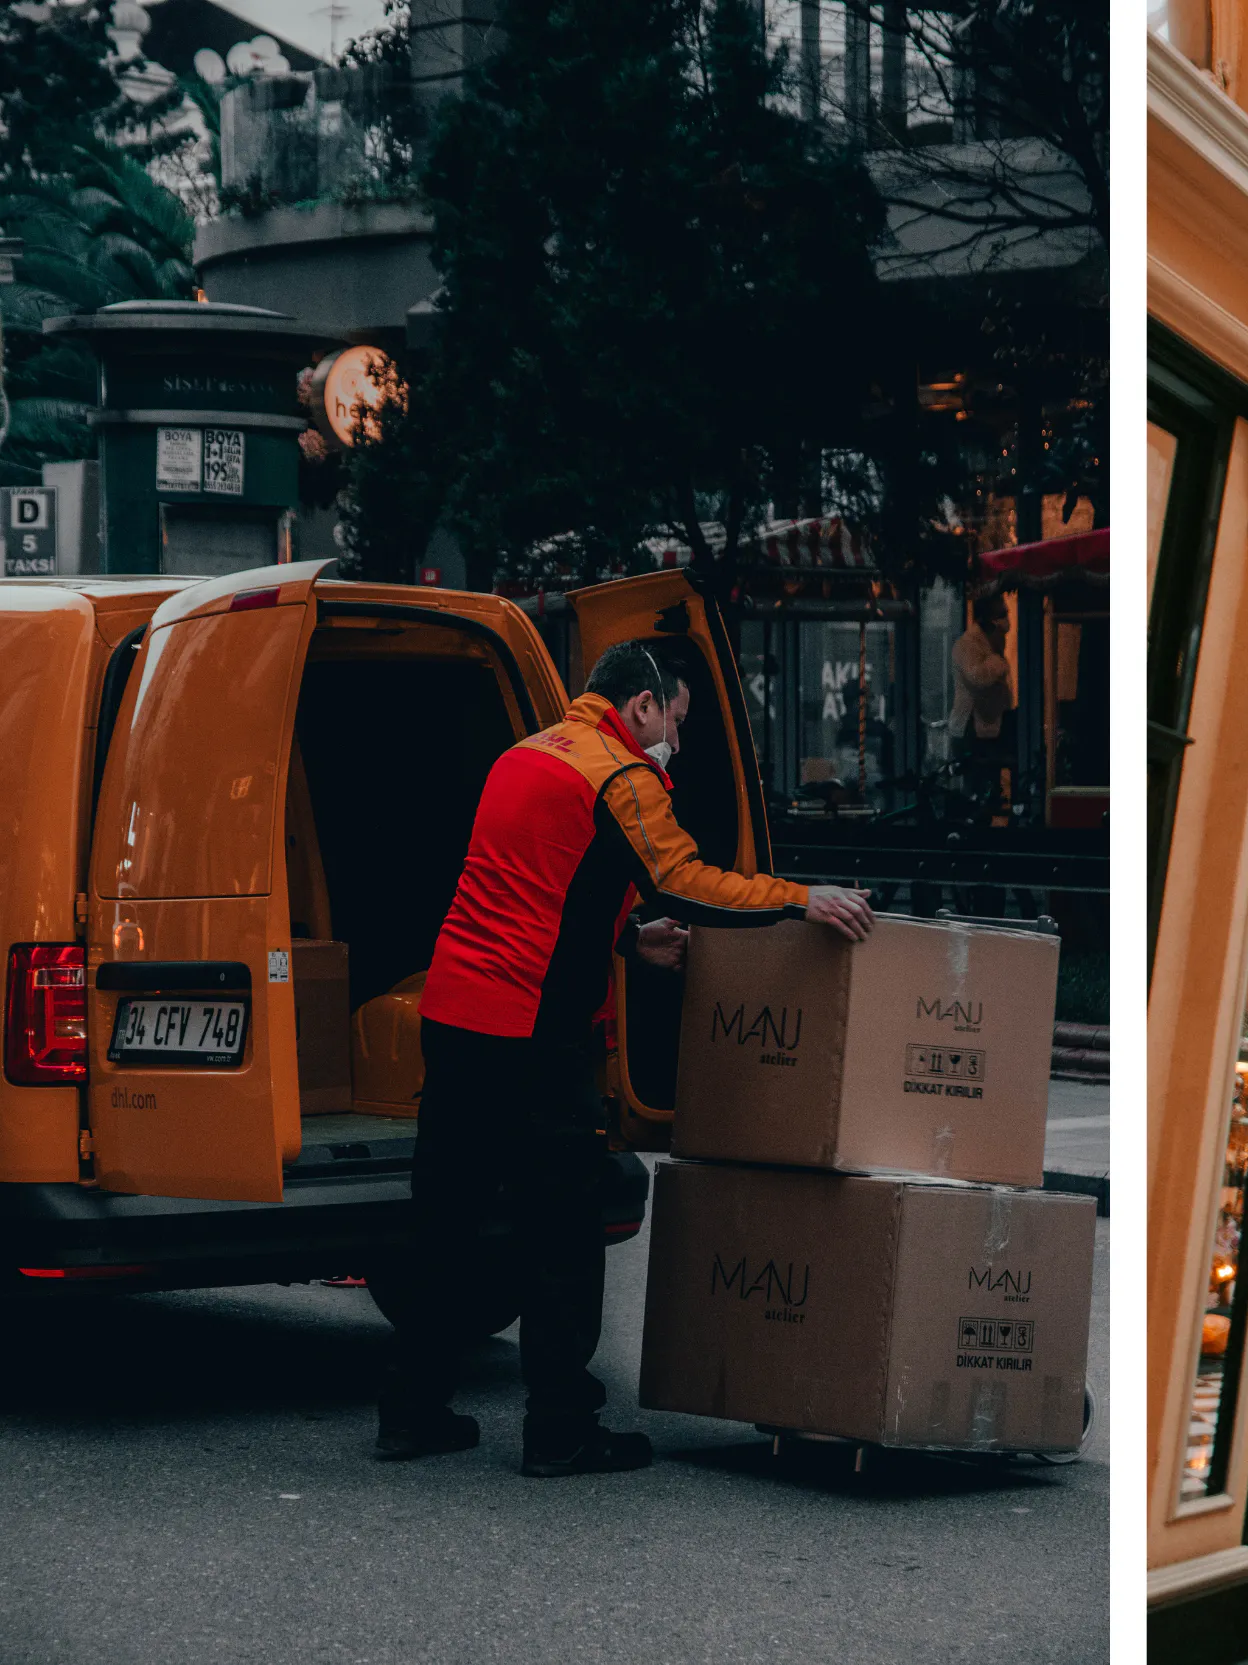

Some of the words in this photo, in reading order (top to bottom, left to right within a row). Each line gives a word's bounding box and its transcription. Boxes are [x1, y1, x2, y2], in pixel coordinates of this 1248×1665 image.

[165, 431, 192, 441] BOYA
[206, 429, 241, 446] BOYA
[205, 461, 227, 481] 195
[18, 499, 39, 523] D
[22, 534, 38, 554] 5
[125, 1007, 145, 1045] 34
[153, 1007, 191, 1046] CFV
[198, 1008, 240, 1048] 748
[953, 1024, 981, 1033] atelier
[759, 1051, 799, 1067] atelier
[111, 1087, 157, 1110] dhl.com
[945, 1084, 983, 1099] KIRILIR
[1003, 1293, 1031, 1303] atelier
[764, 1307, 805, 1324] atelier
[956, 1352, 993, 1370] DİKKAT
[996, 1356, 1032, 1371] KIRILIR
